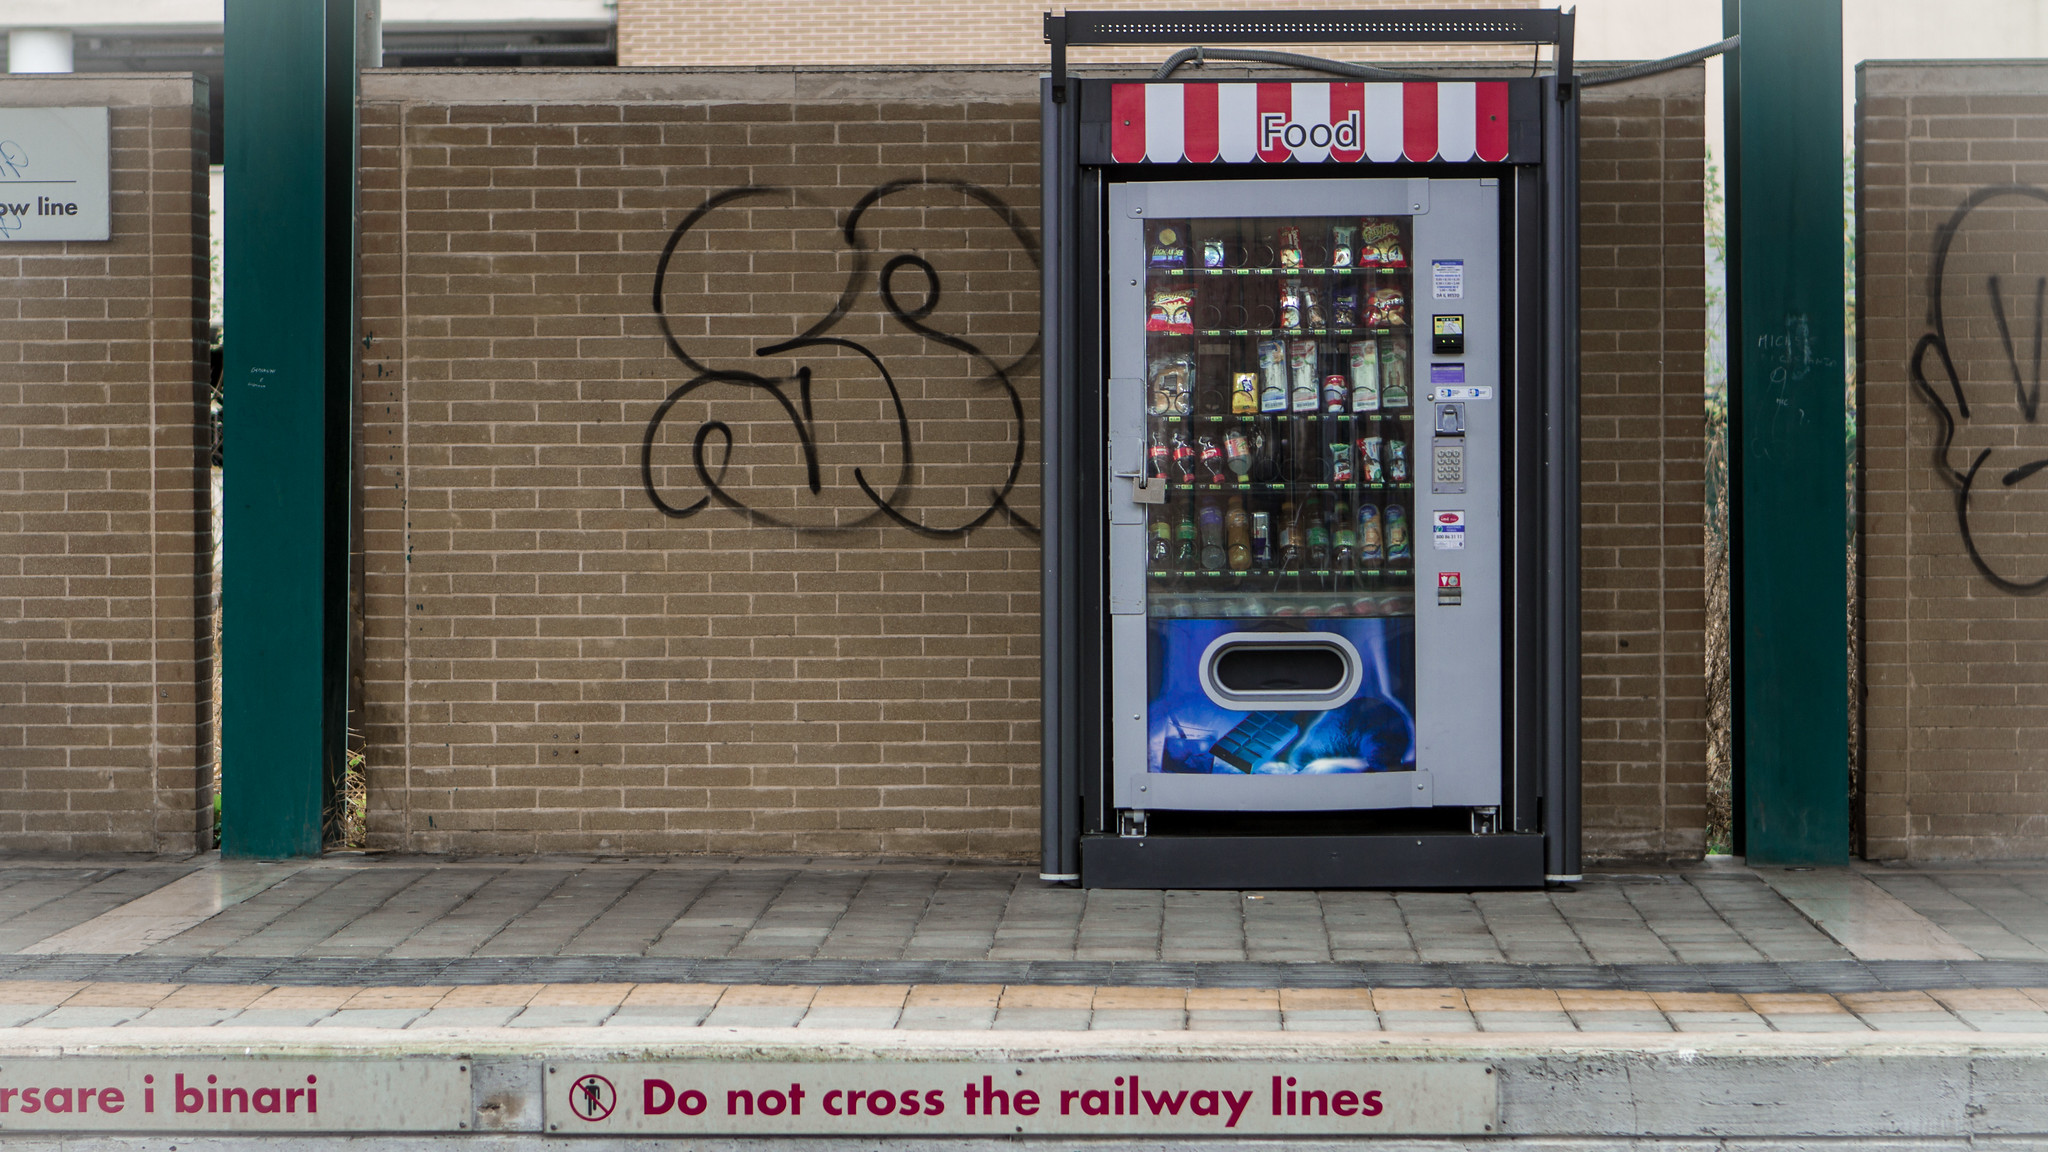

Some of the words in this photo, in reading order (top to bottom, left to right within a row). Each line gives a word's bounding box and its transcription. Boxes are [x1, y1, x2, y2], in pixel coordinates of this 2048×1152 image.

[1263, 112, 1358, 149] Food
[38, 197, 78, 216] line
[0, 1088, 125, 1114] rsare
[144, 1074, 154, 1113] i
[175, 1073, 317, 1114] binari
[643, 1079, 708, 1116] Do
[727, 1083, 806, 1117] not
[822, 1089, 945, 1117] cross
[963, 1075, 1041, 1117] the
[1060, 1075, 1254, 1128] railway
[1271, 1075, 1384, 1117] lines
